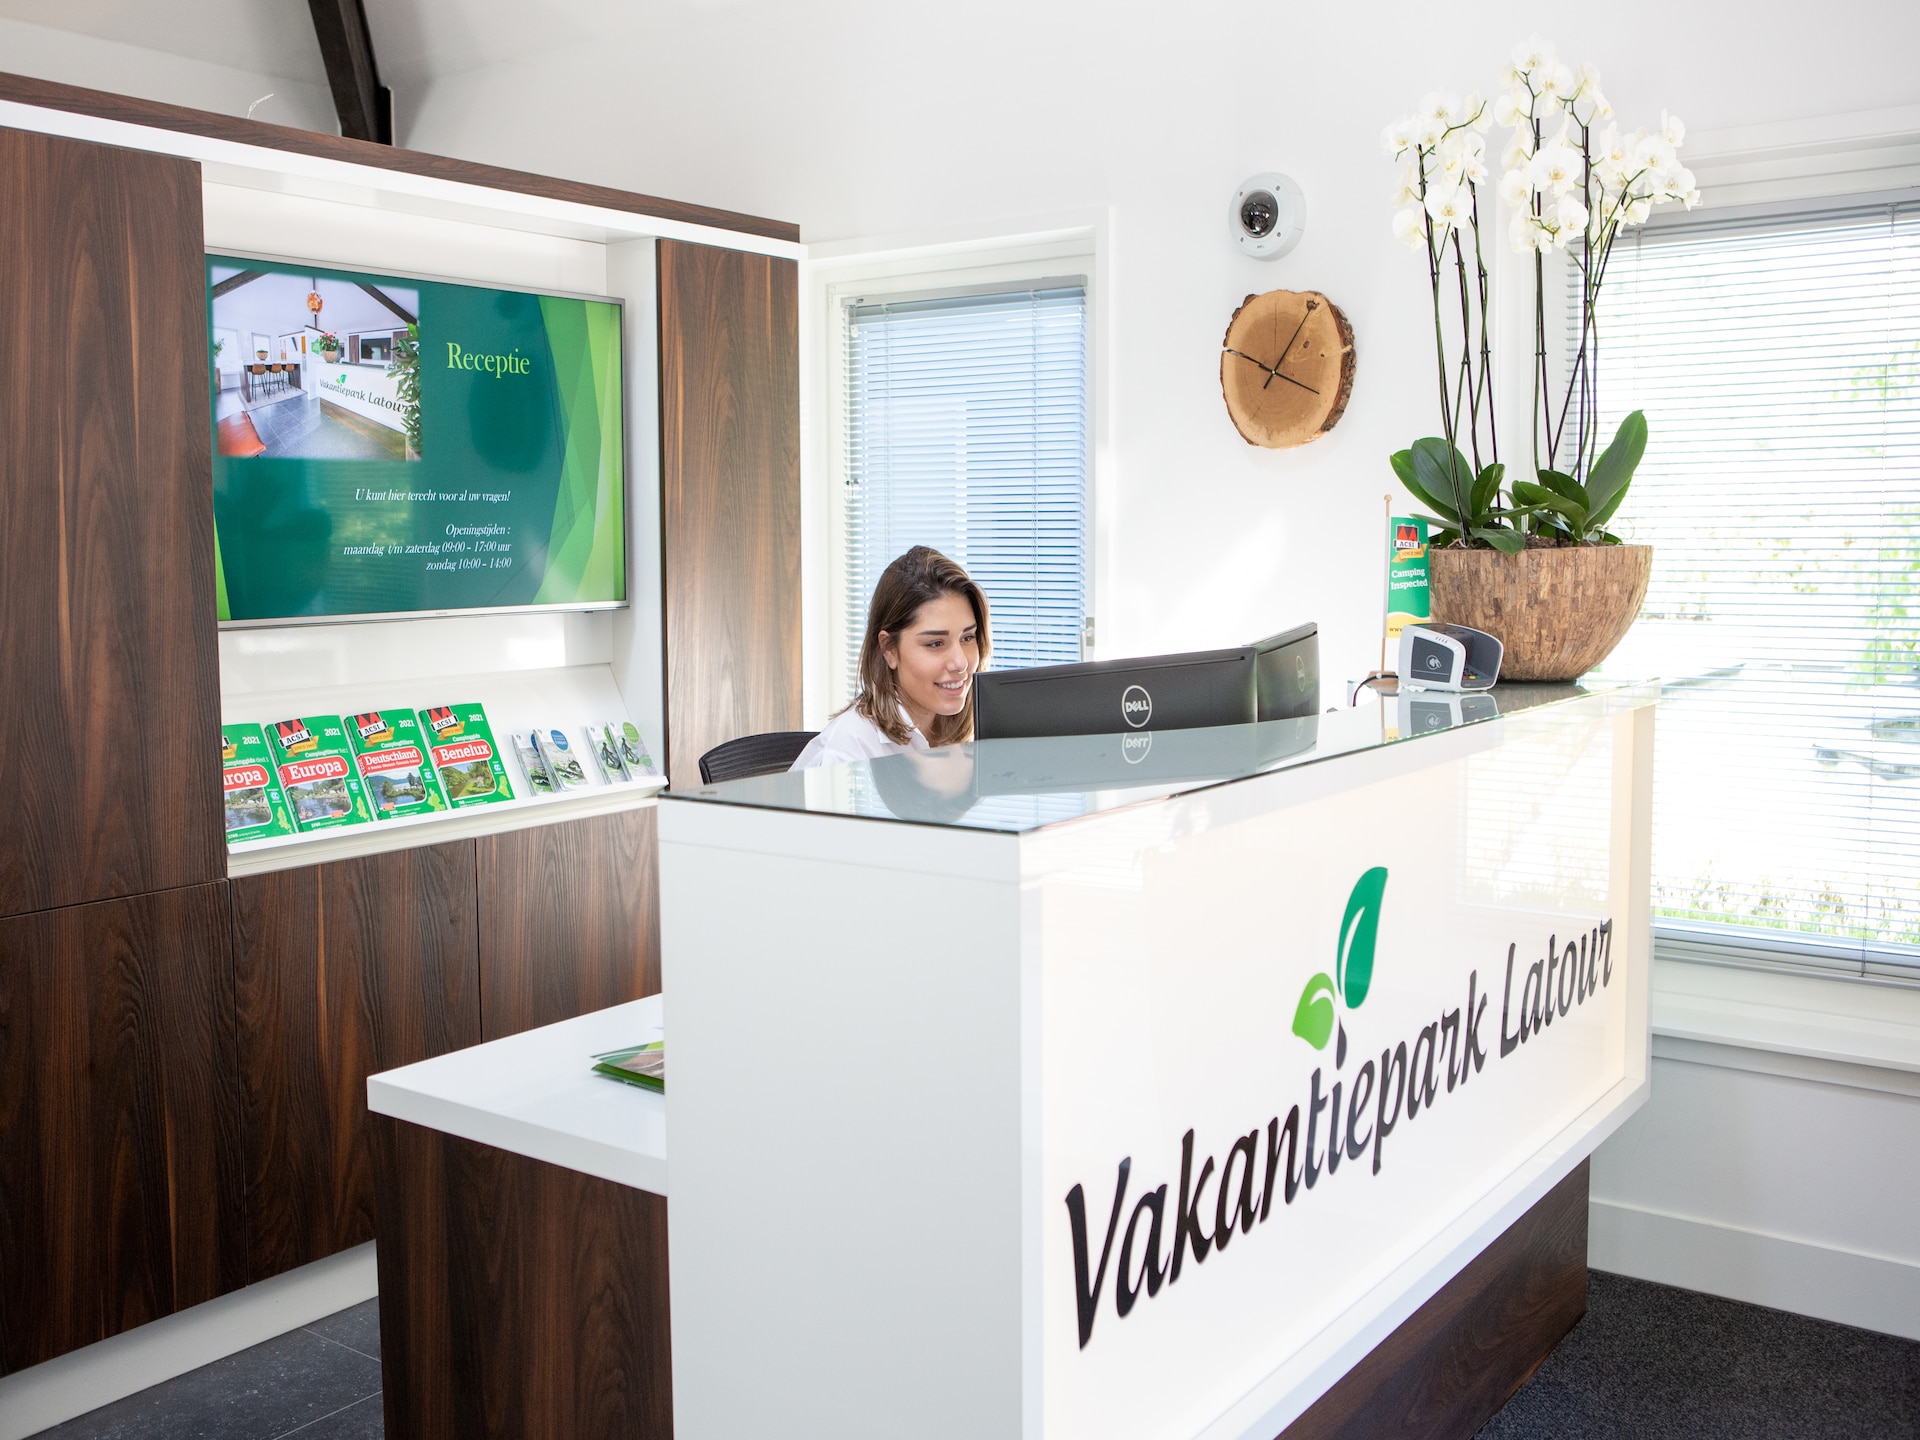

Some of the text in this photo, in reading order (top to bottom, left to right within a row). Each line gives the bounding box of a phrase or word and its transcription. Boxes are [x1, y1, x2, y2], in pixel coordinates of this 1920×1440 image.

[446, 342, 531, 379] Receptie
[320, 378, 409, 414] Vakantiepark Latour
[355, 488, 511, 504] U kunt hier terecht voor al uw vragen!
[445, 524, 506, 538] Openingstijden
[343, 542, 385, 557] maandag
[387, 542, 403, 555] t/m
[404, 541, 441, 555] zaterdag
[441, 541, 466, 553] 09:00
[474, 541, 497, 552] 17:00
[497, 543, 512, 552] uur
[425, 558, 457, 572] zondag
[458, 558, 481, 569] 10:00
[489, 557, 512, 569] 14:00
[1391, 568, 1426, 579] Camping
[1391, 579, 1429, 590] Inspected
[1125, 700, 1149, 713] DELL
[398, 719, 415, 728] 2021
[436, 718, 453, 728] ACSI
[468, 713, 484, 722] 2021
[323, 727, 342, 737] 2021
[364, 724, 381, 735] ACSI
[242, 736, 261, 745] 2021
[286, 732, 305, 744] ACSI
[364, 749, 418, 765] Deutschland
[438, 743, 490, 762] Benelux
[223, 770, 263, 785] ropa
[287, 761, 343, 780] Europa
[1065, 918, 1613, 1351] Vakantiepark Latour
